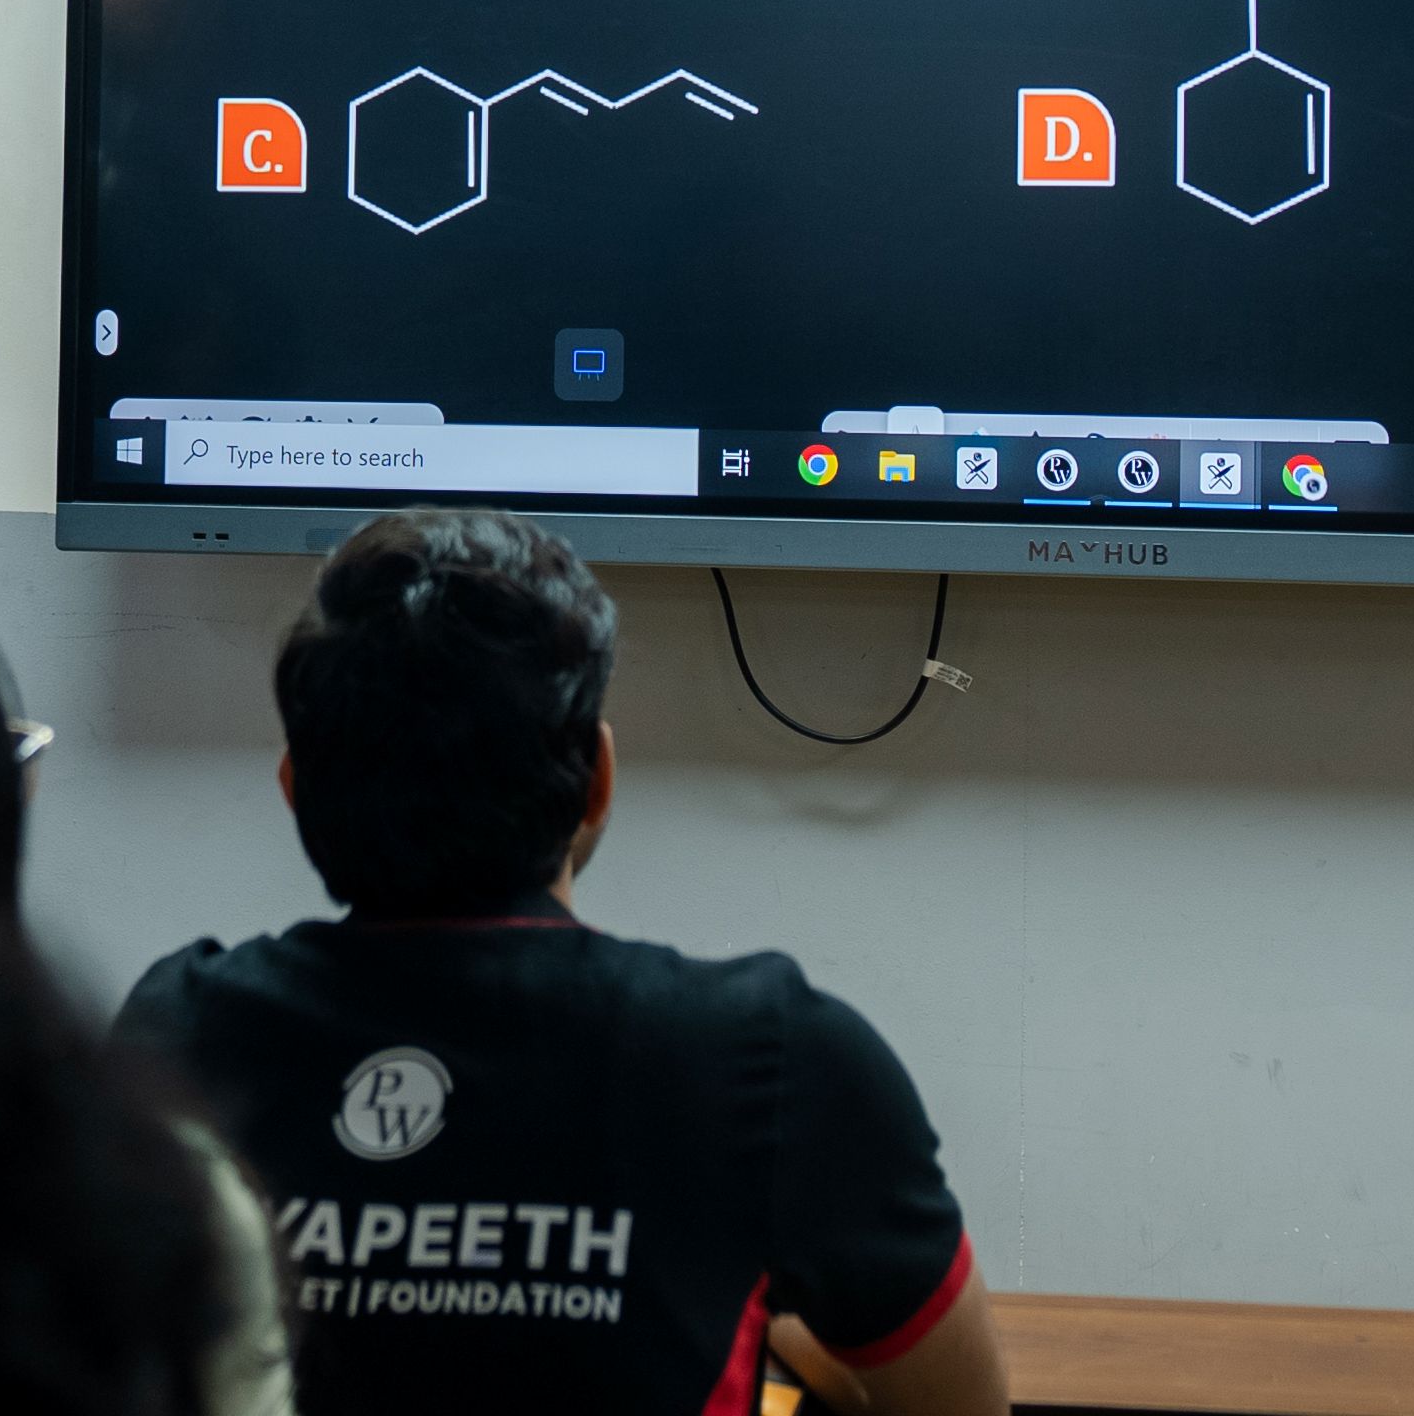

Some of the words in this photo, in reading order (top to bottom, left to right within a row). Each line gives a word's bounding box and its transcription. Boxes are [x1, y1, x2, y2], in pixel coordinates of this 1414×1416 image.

[242, 129, 284, 173] C.
[1044, 116, 1093, 162] D.
[226, 445, 274, 469] Type
[281, 443, 326, 466] here
[332, 448, 353, 467] to
[358, 448, 424, 469] search
[367, 1280, 622, 1323] FOUNDATION
